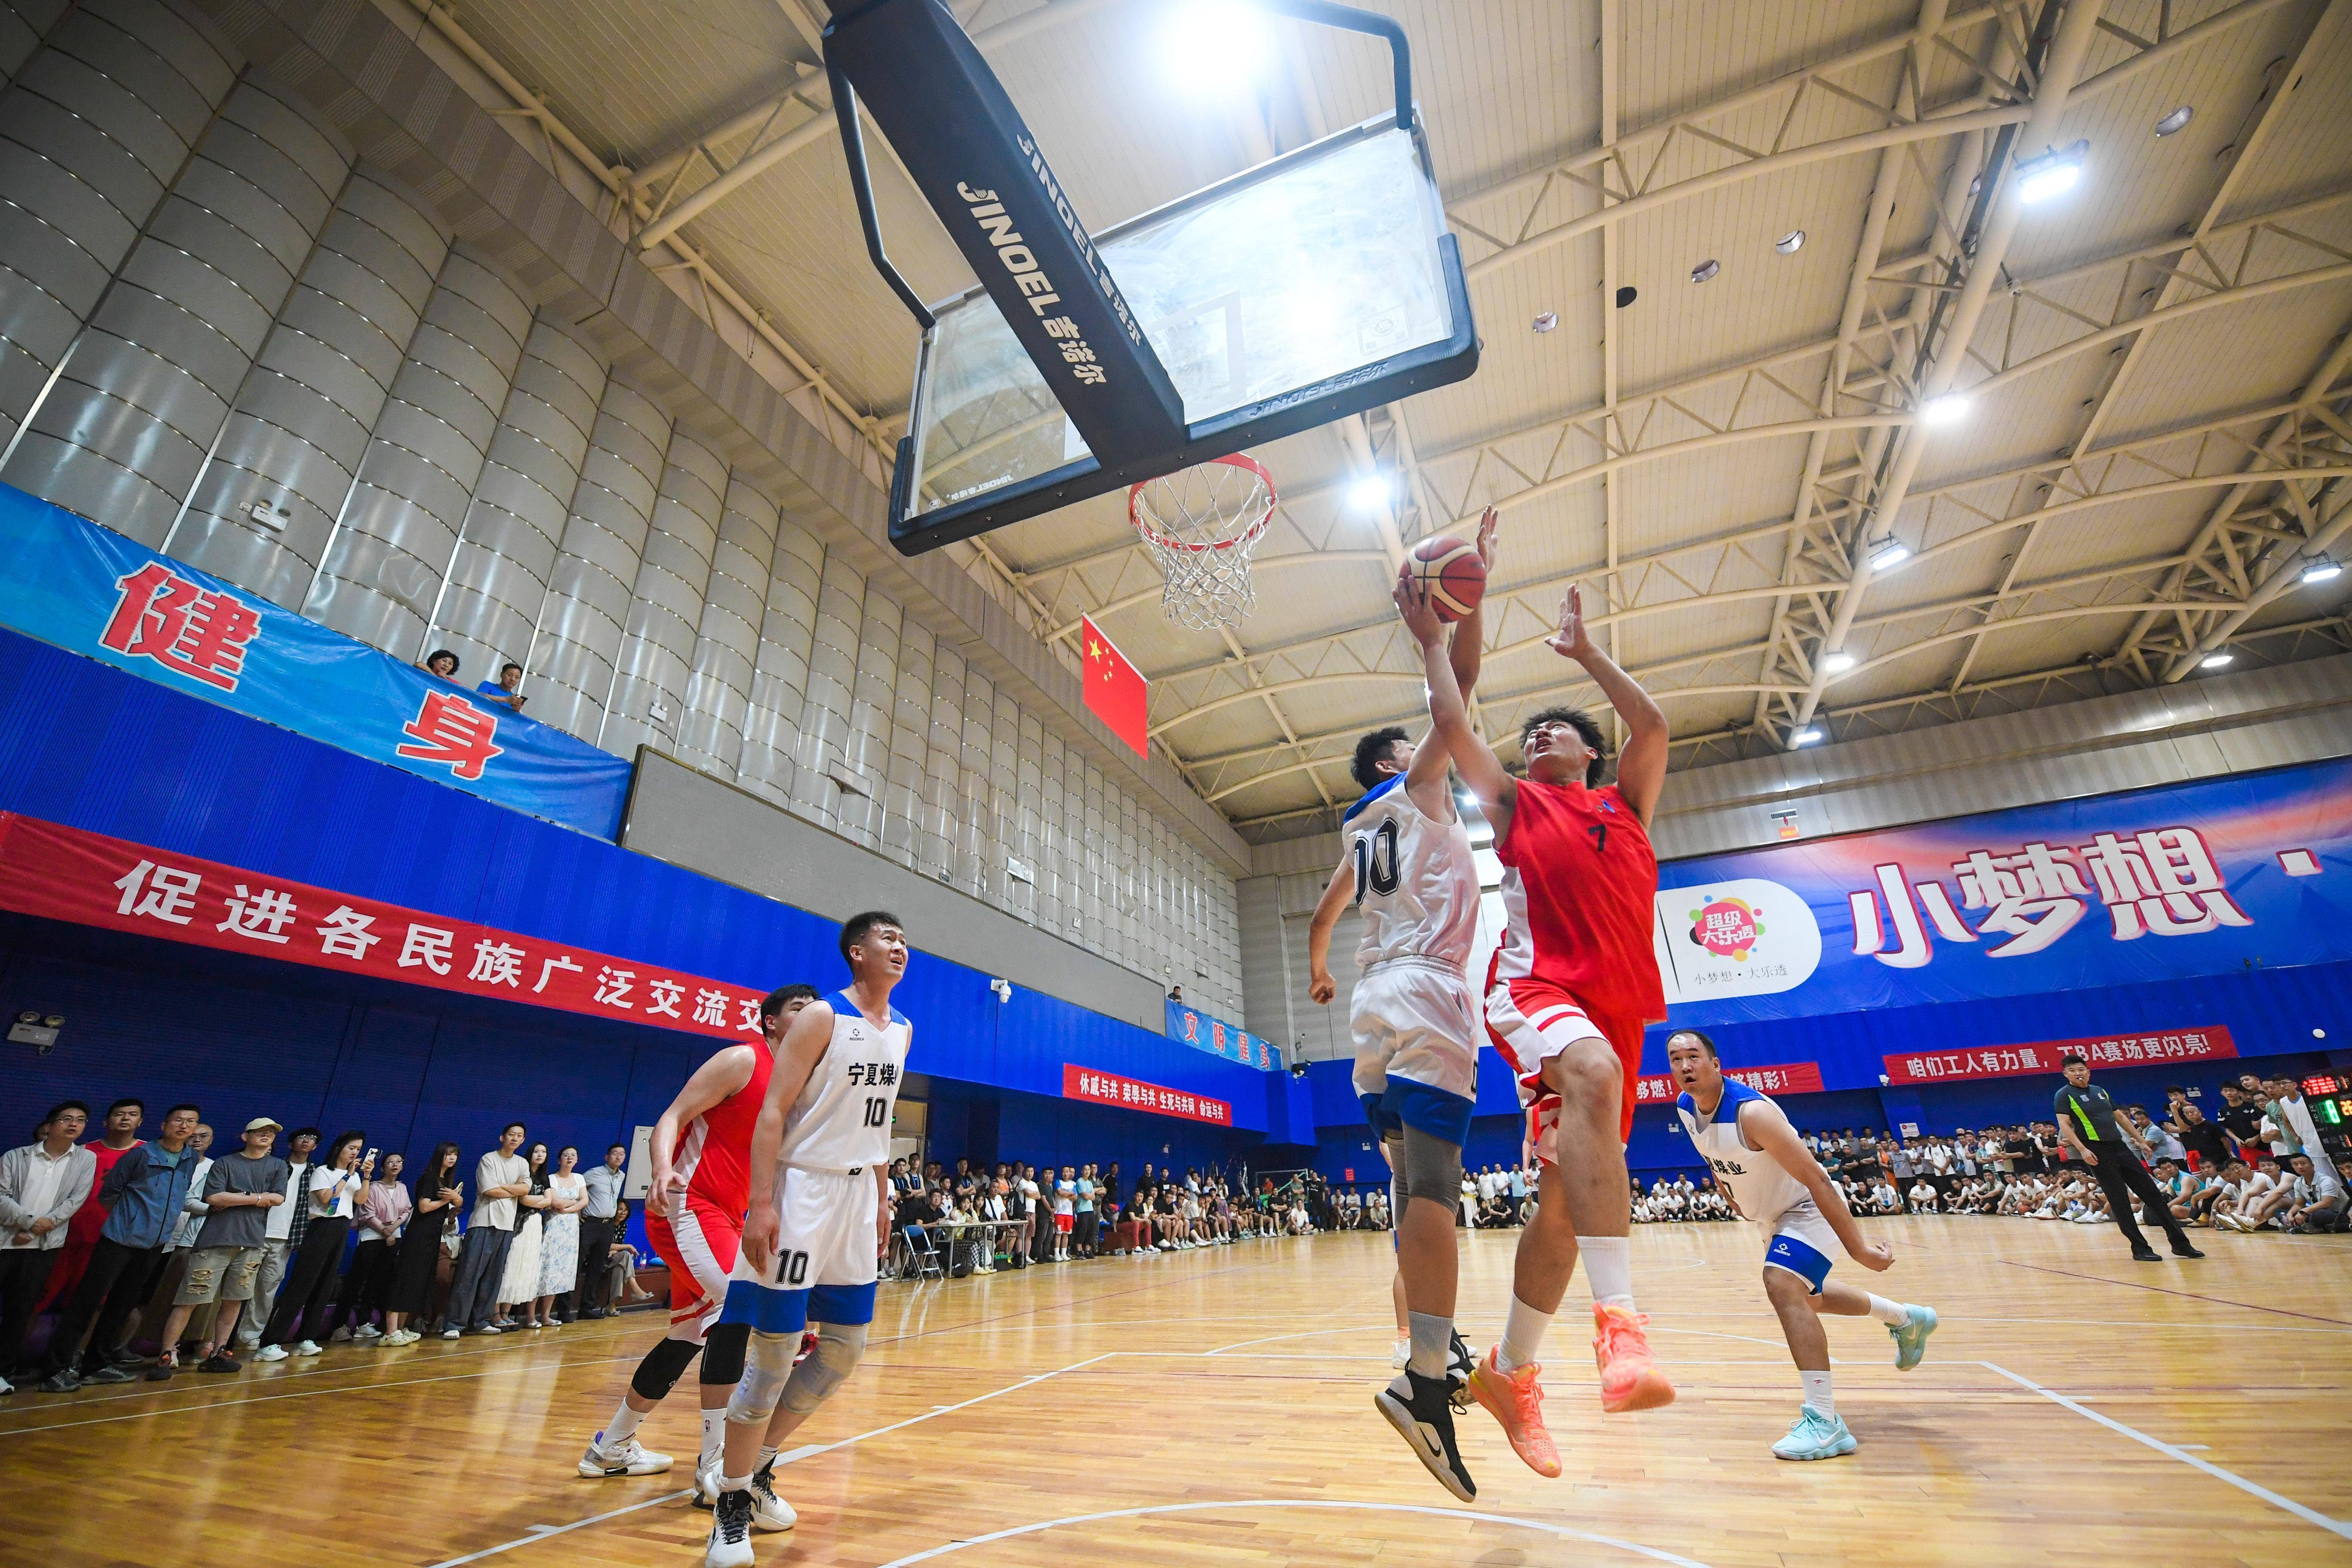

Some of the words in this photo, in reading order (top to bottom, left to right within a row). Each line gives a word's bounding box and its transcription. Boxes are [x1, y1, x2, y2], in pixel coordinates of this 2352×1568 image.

[1016, 134, 1098, 275] JINOEL
[957, 181, 1060, 316] JINOEL
[1042, 316, 1107, 385] 吉诺尔
[1588, 824, 1606, 852] 7
[1705, 910, 1743, 929] 超级
[863, 1097, 888, 1128] 10
[1080, 1073, 1118, 1100] 休戚与共
[1123, 1082, 1156, 1107] 荣辱与共
[1199, 1100, 1224, 1120] 命运与共
[775, 1248, 809, 1286] 10
